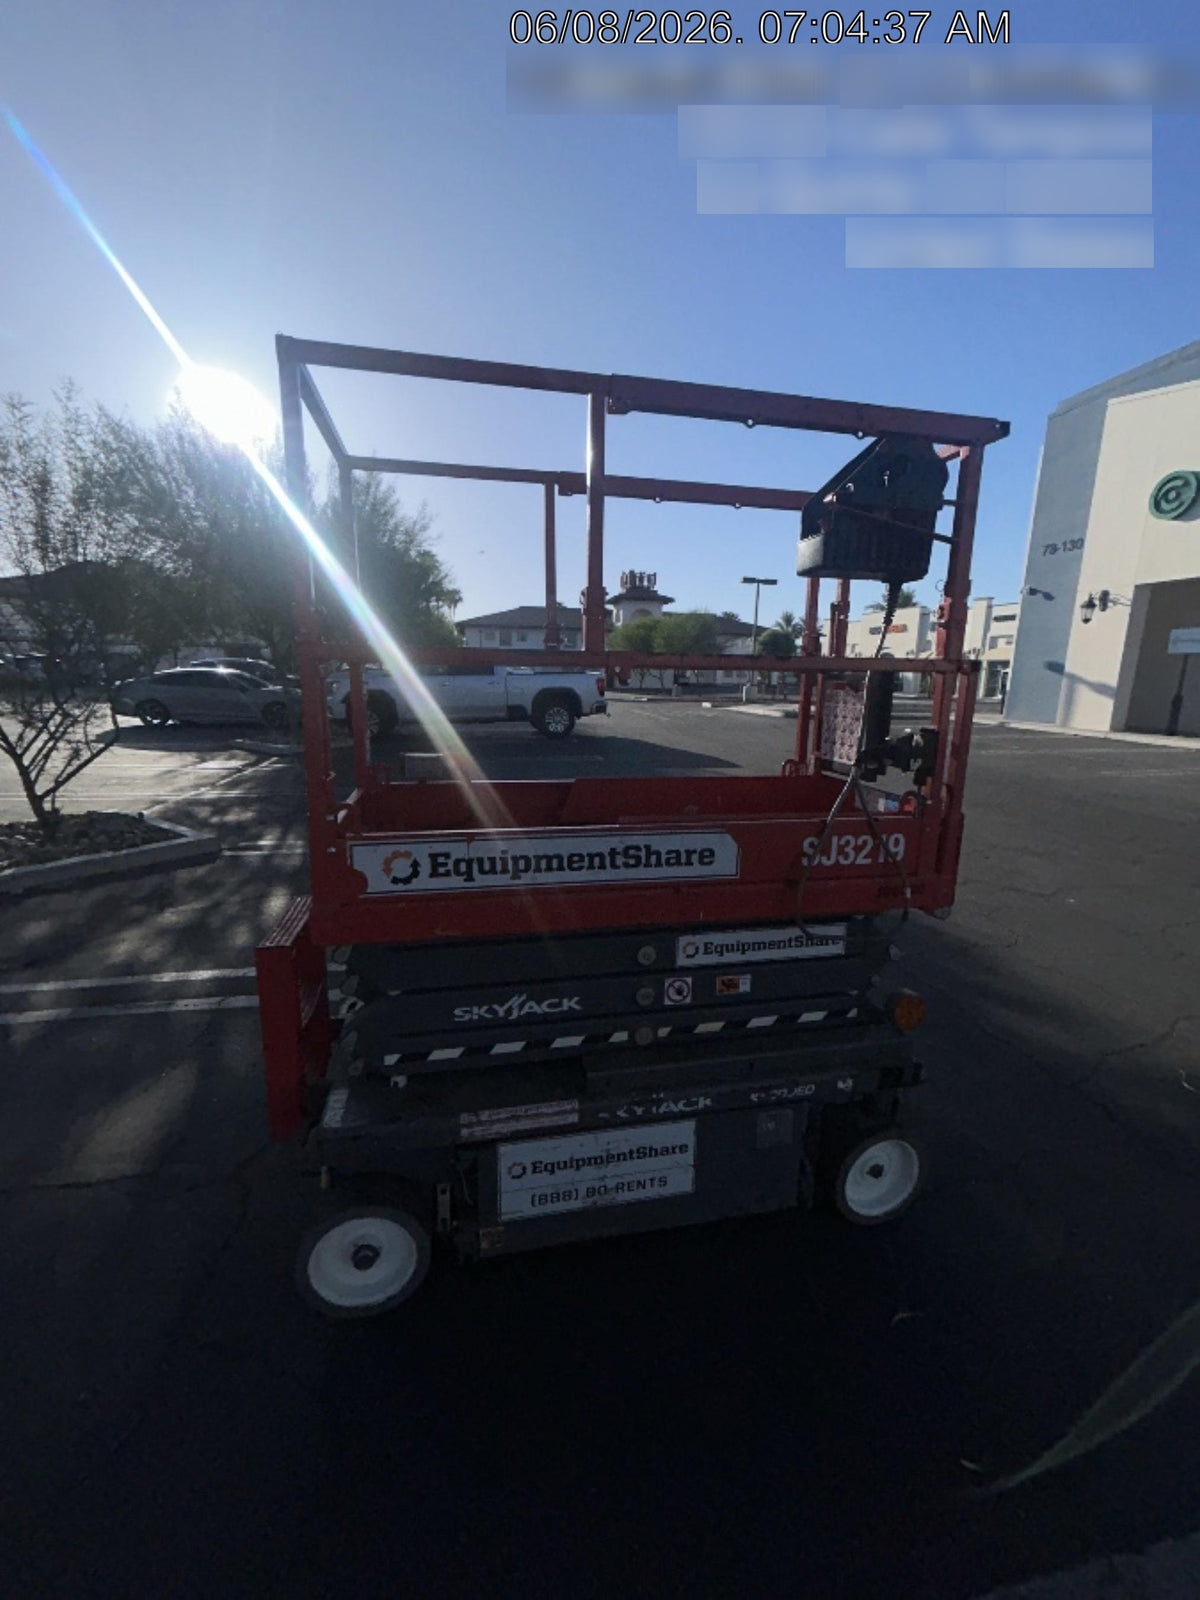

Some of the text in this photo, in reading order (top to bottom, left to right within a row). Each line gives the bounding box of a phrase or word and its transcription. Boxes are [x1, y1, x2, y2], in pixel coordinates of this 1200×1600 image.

[428, 842, 716, 881] EquipmentShare
[801, 833, 906, 866] SJ3219
[452, 994, 582, 1022] SKYJACK
[531, 1144, 689, 1177] EquipmentShare
[531, 1188, 580, 1208] (888)
